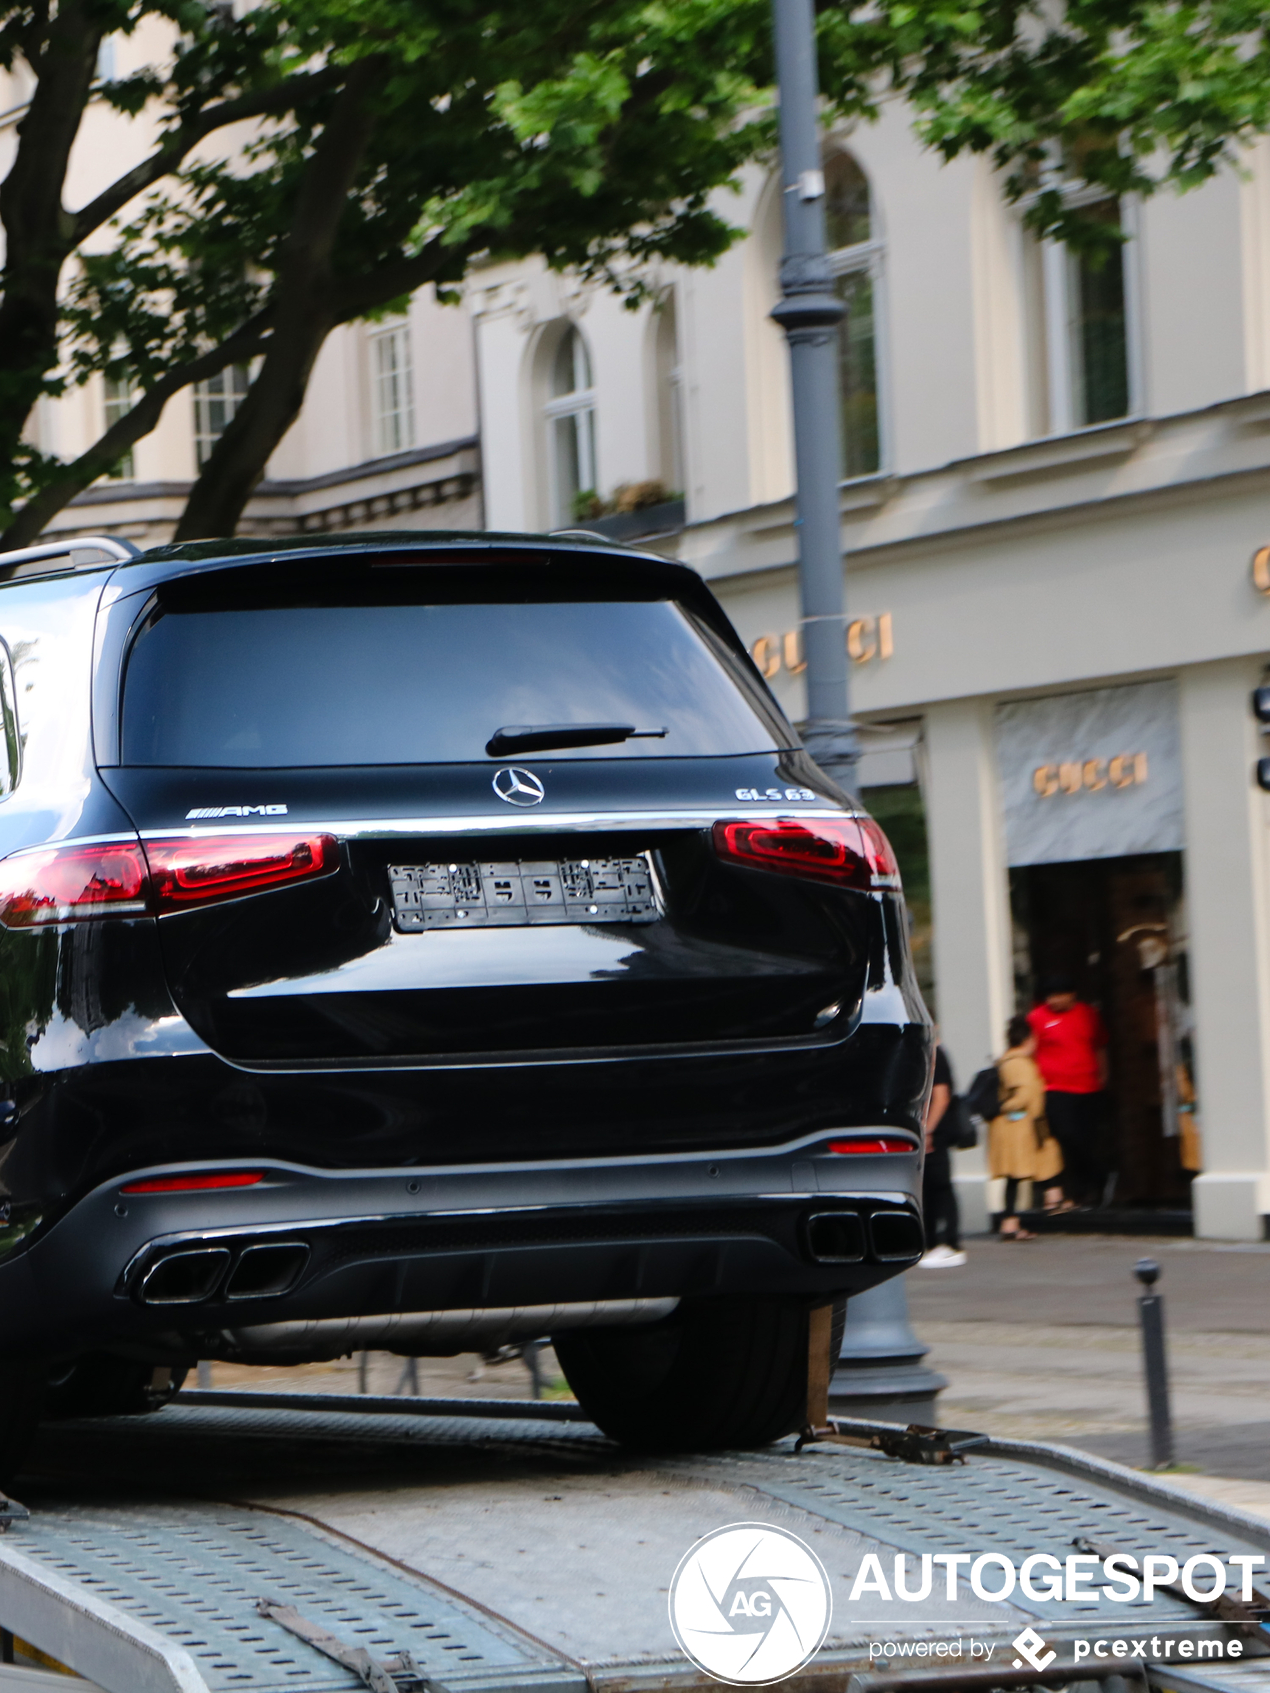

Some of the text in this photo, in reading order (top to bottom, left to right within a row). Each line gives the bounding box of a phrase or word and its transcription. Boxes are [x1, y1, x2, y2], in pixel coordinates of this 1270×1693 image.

[752, 612, 893, 679] GUCI
[1033, 751, 1148, 797] GUCCI
[735, 788, 816, 801] GLS 63
[216, 804, 288, 818] AMG
